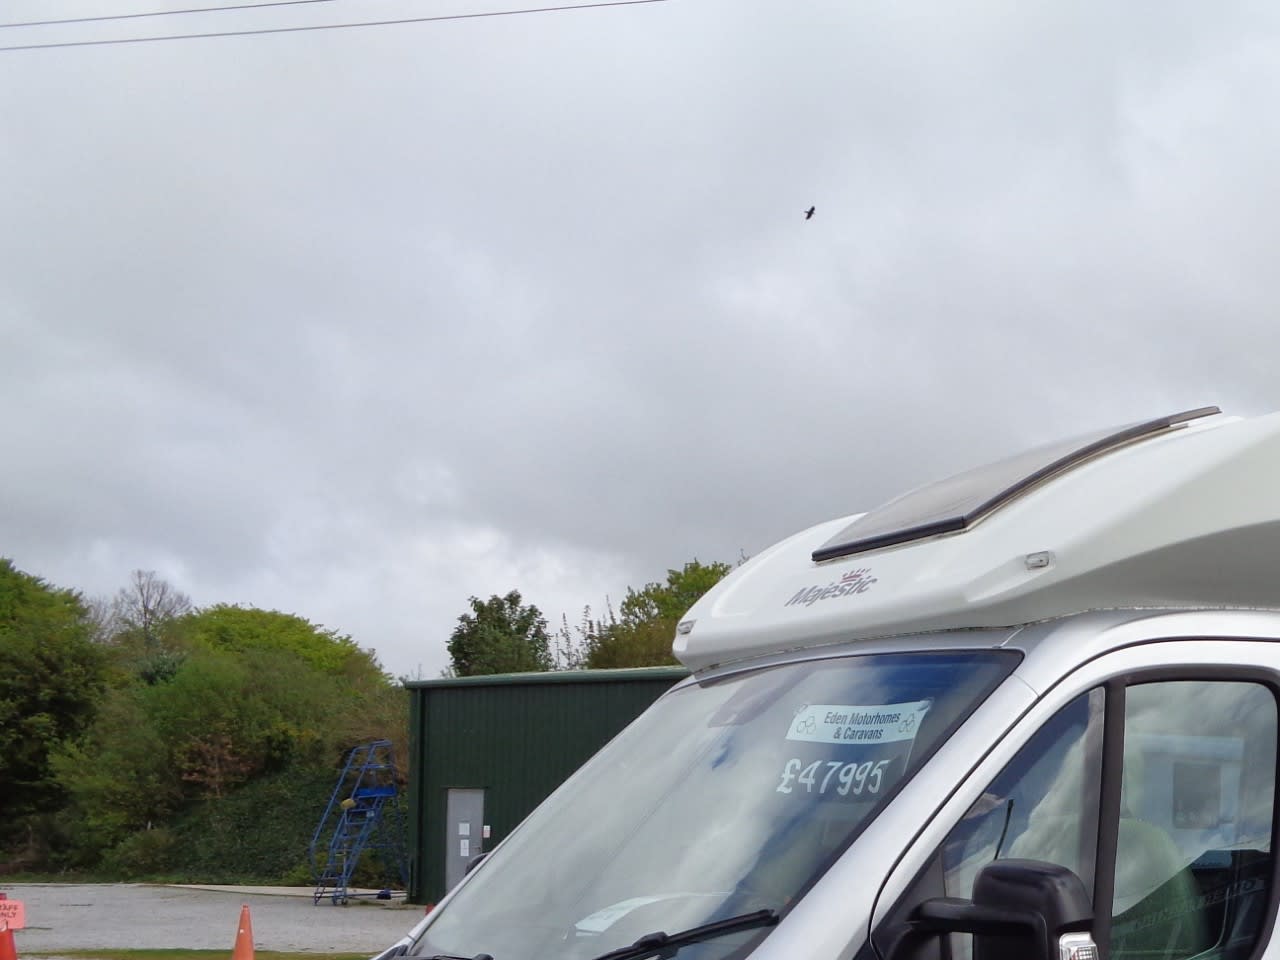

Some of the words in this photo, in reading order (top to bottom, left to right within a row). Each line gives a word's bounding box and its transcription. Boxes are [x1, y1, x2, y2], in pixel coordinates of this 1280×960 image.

[784, 575, 878, 608] Majestic
[823, 711, 847, 724] Eden
[849, 711, 901, 726] Motorhomes
[833, 727, 842, 739] &
[843, 727, 884, 740] Caravans
[776, 758, 892, 796] £47995
